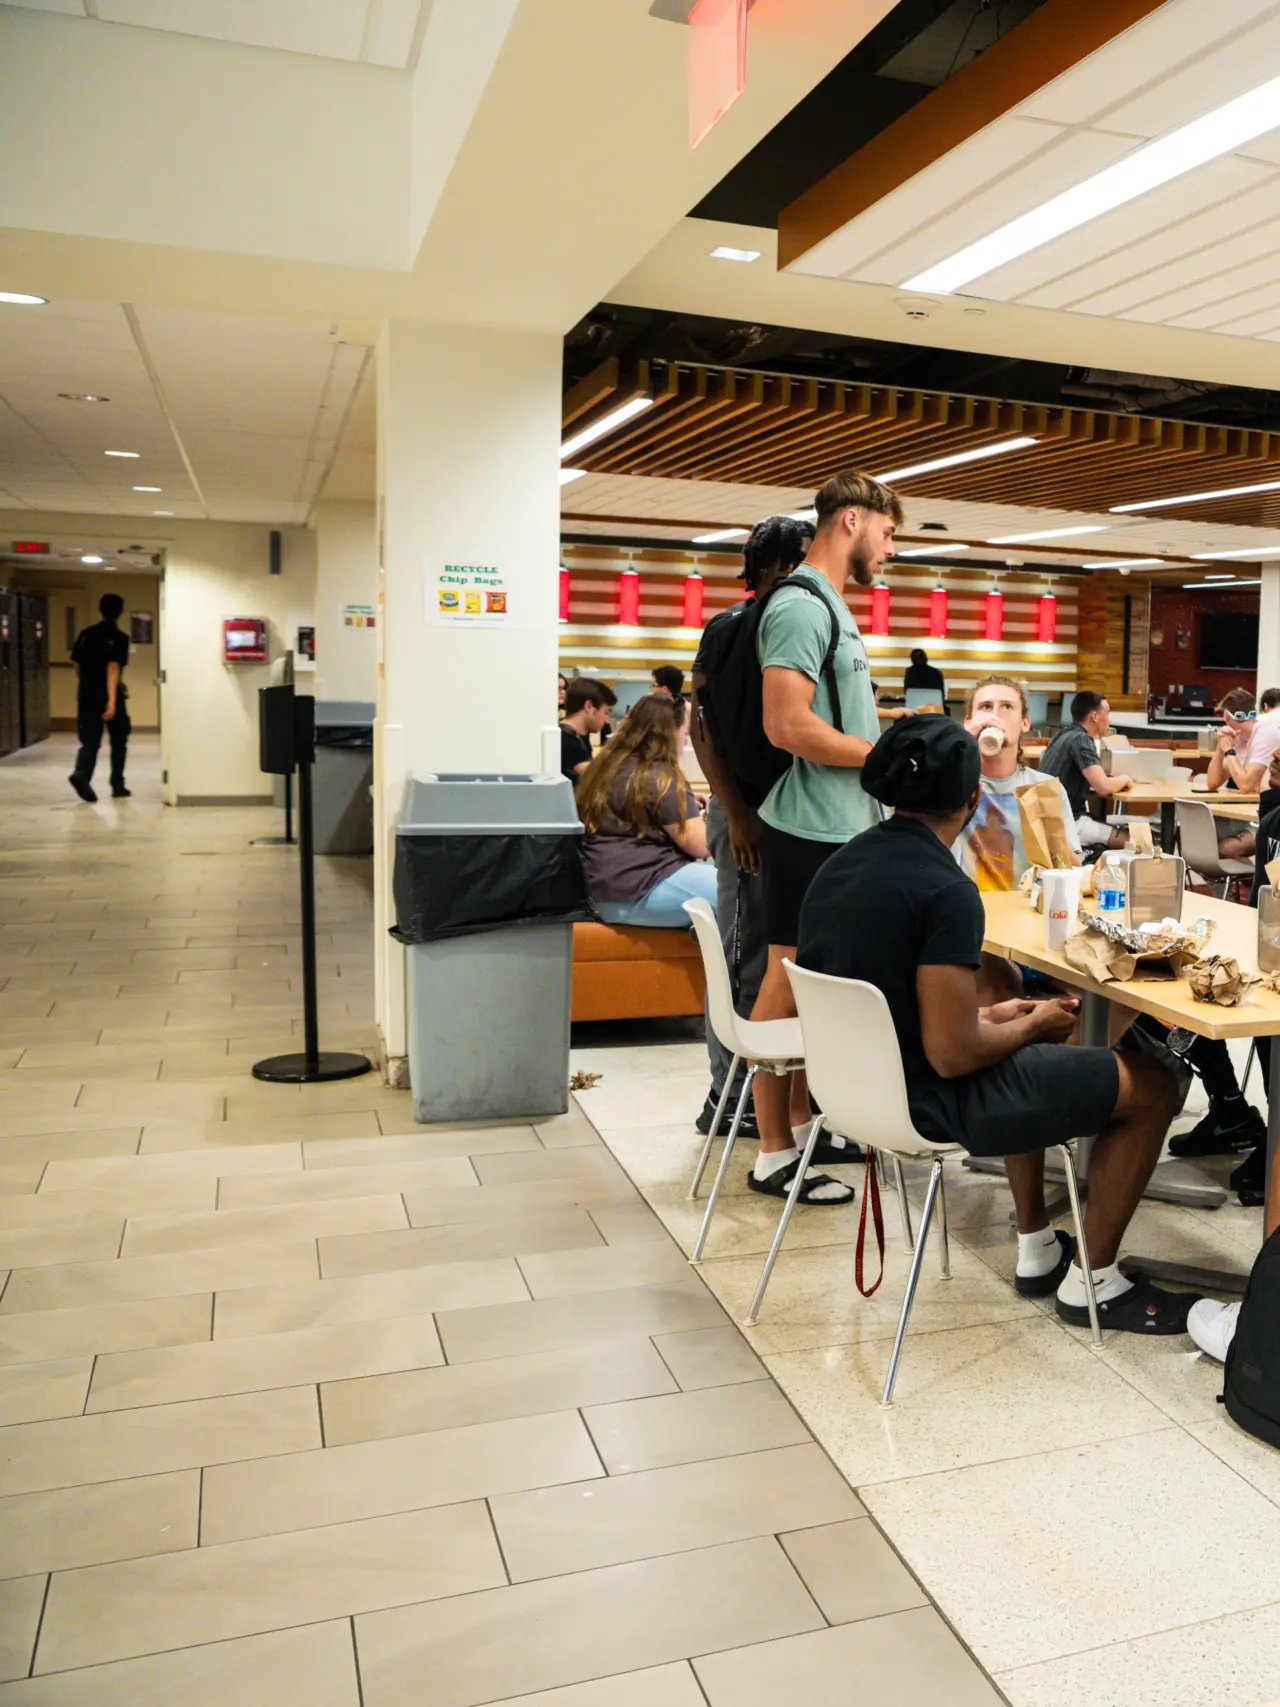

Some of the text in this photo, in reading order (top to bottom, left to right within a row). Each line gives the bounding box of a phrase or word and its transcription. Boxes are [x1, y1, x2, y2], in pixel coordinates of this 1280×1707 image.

[444, 564, 499, 574] RECYCLE
[439, 575, 504, 586] Chip Bags
